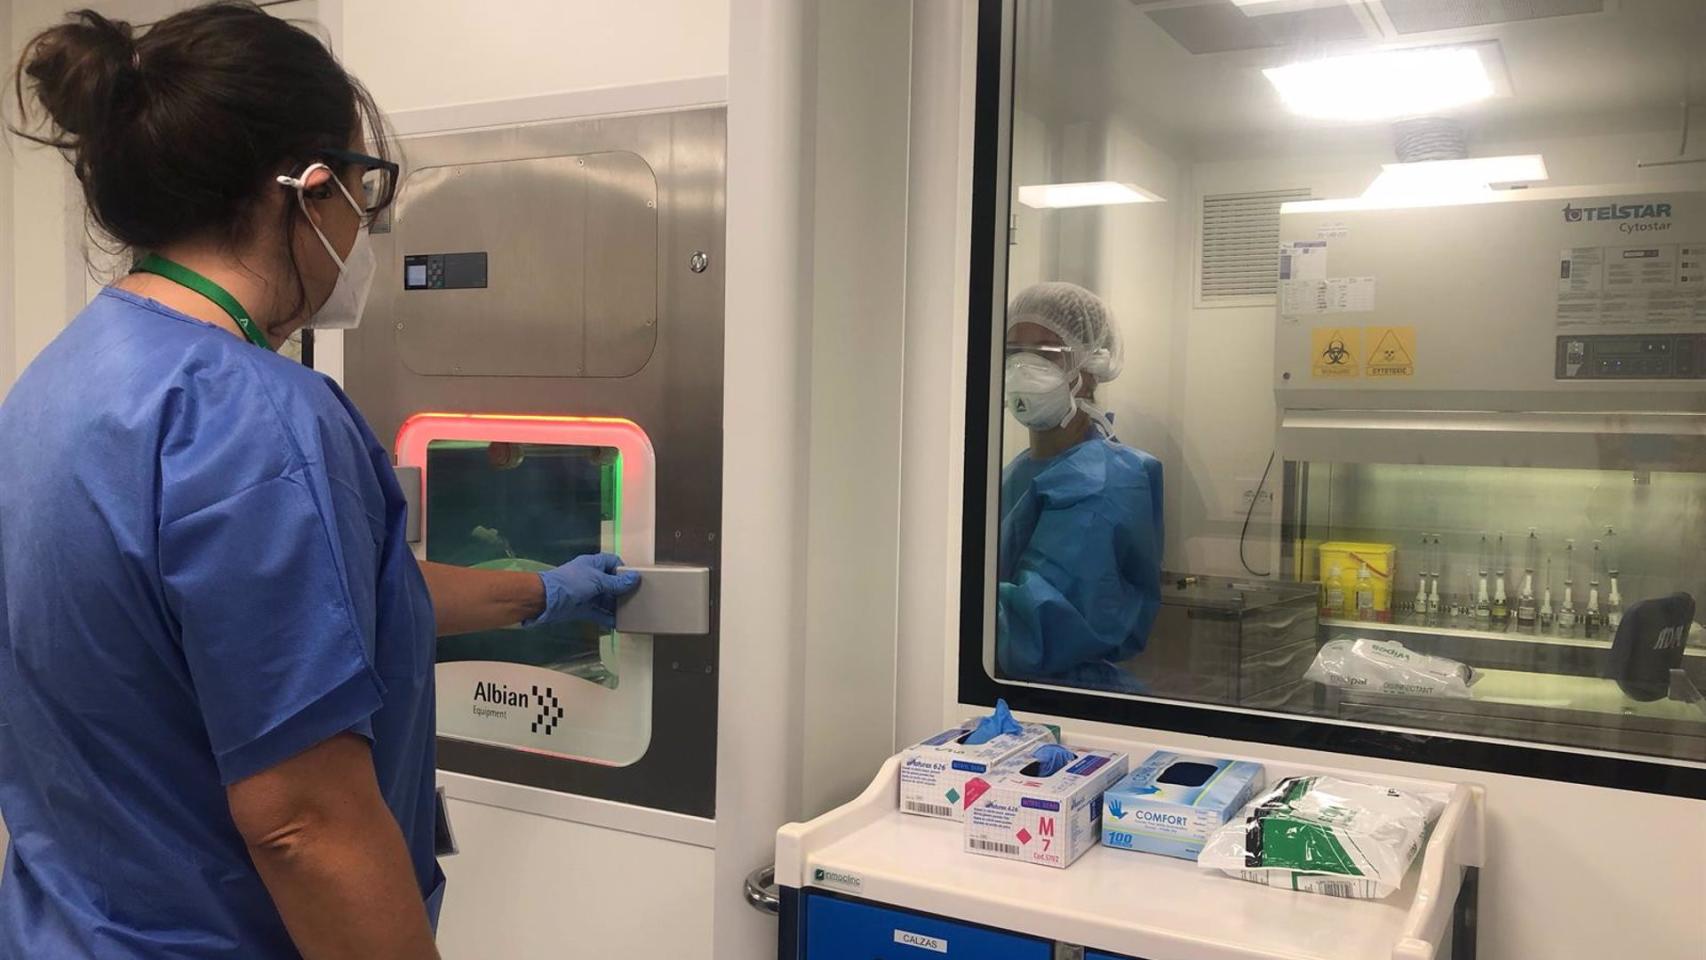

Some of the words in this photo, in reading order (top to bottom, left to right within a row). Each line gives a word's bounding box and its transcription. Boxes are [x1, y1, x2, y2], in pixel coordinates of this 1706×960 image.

[1583, 203, 1673, 221] TELSTAR
[1618, 222, 1673, 234] Cytostar
[474, 681, 529, 708] Albian
[473, 705, 508, 719] Equipment
[933, 762, 946, 771] 626
[1135, 810, 1188, 826] COMFORT
[1038, 816, 1054, 837] M
[1041, 838, 1051, 852] 7
[1108, 831, 1133, 846] 100
[903, 934, 938, 949] CALZAS
